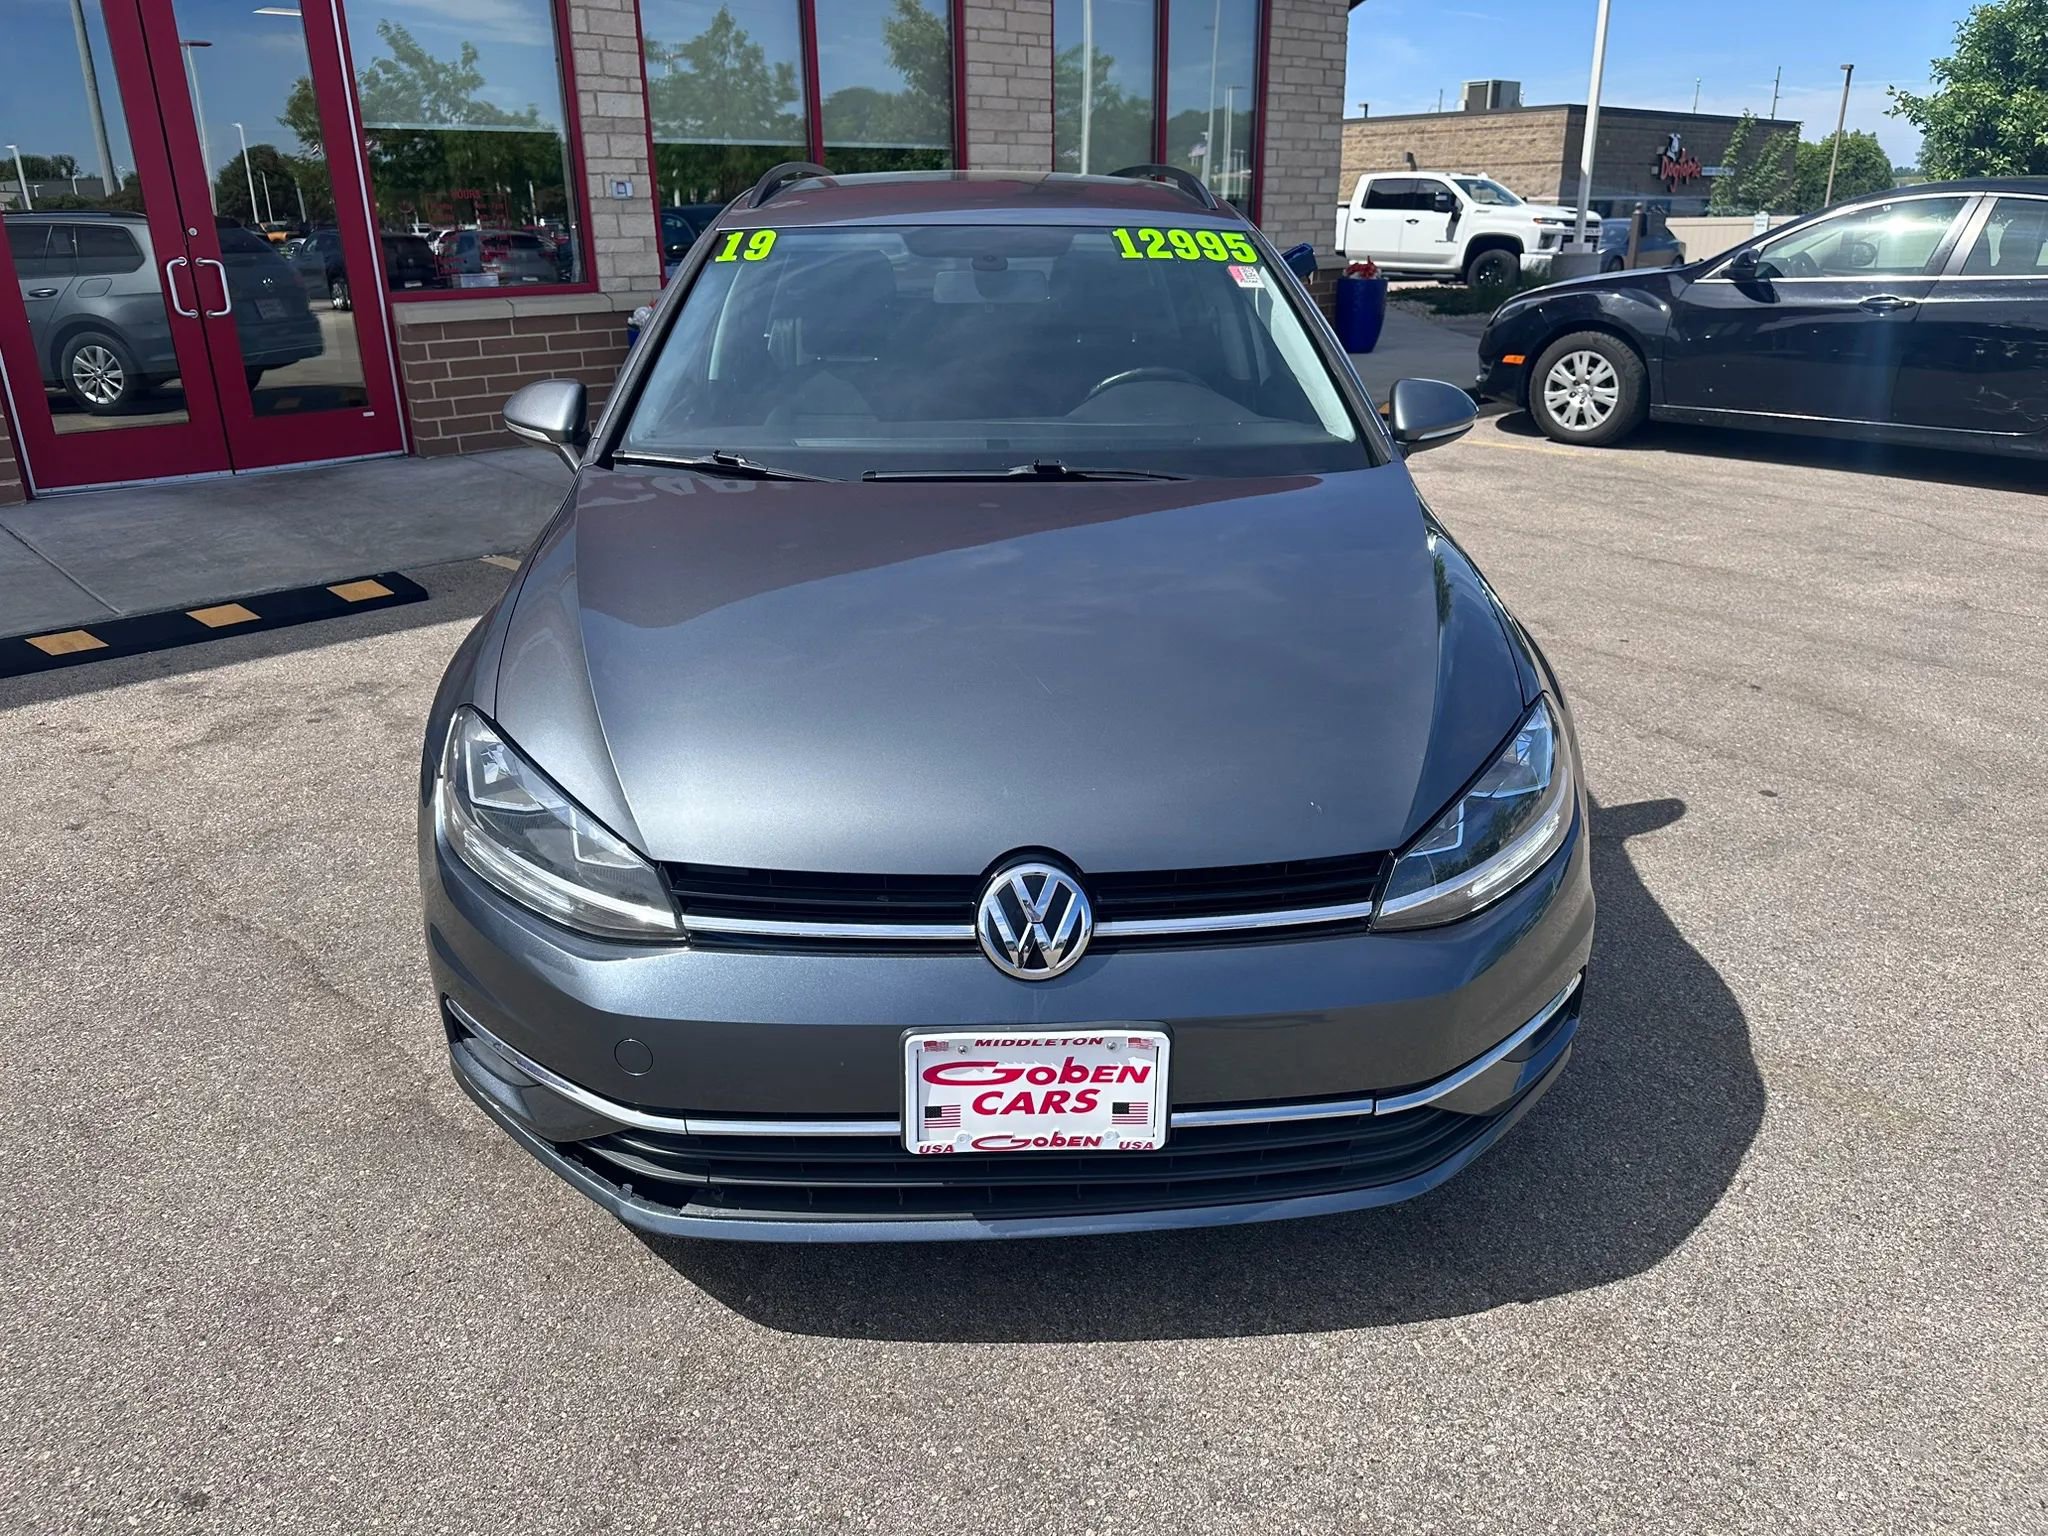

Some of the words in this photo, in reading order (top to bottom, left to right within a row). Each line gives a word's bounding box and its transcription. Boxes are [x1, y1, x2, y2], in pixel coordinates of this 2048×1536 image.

[715, 230, 777, 262] 19
[1112, 228, 1258, 263] 12995
[974, 1037, 1104, 1047] MIDDLETON
[972, 1089, 1101, 1115] CARS
[919, 1145, 954, 1154] USA
[1119, 1141, 1154, 1150] USA
